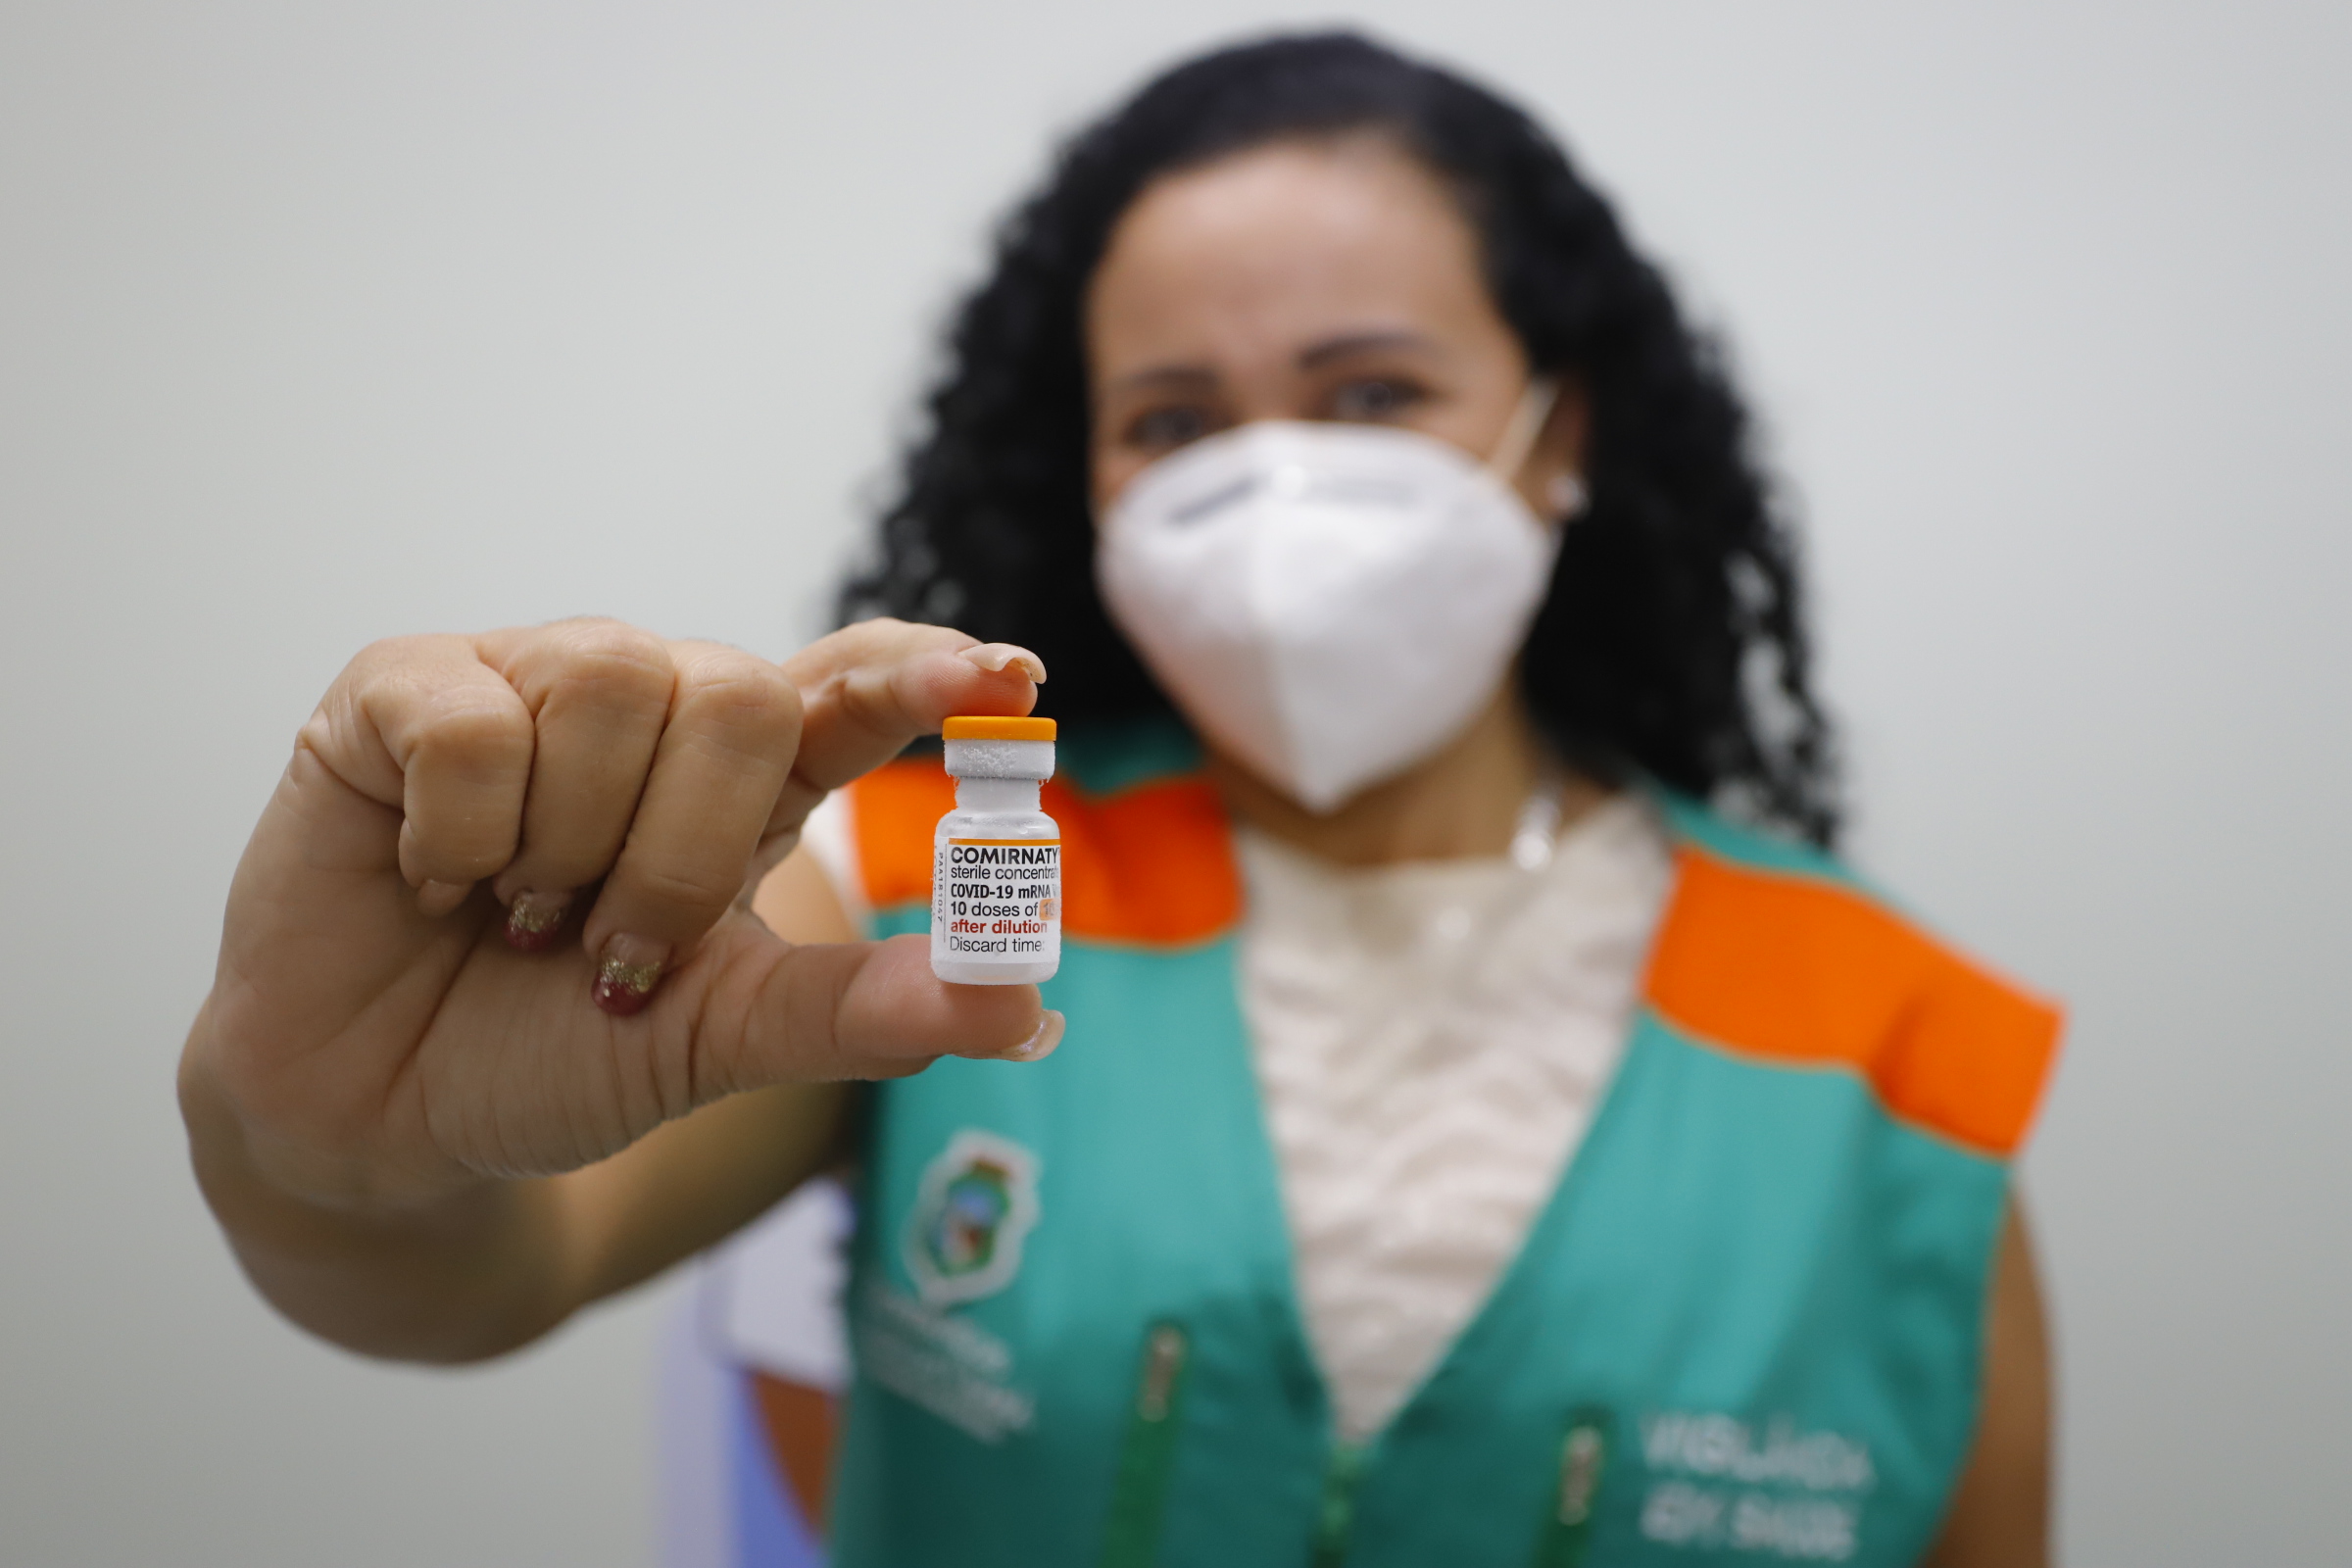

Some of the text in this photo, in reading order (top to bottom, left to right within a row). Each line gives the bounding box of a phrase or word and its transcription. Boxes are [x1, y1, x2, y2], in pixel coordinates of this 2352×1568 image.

[951, 865, 991, 879] sterile
[951, 883, 1013, 899] COVID-19
[1018, 885, 1051, 899] mRNA
[951, 902, 966, 915] 10
[971, 903, 1020, 916] doses
[1025, 903, 1038, 916] of
[951, 919, 1047, 934] after dilution
[950, 936, 1045, 953] Discard time:
